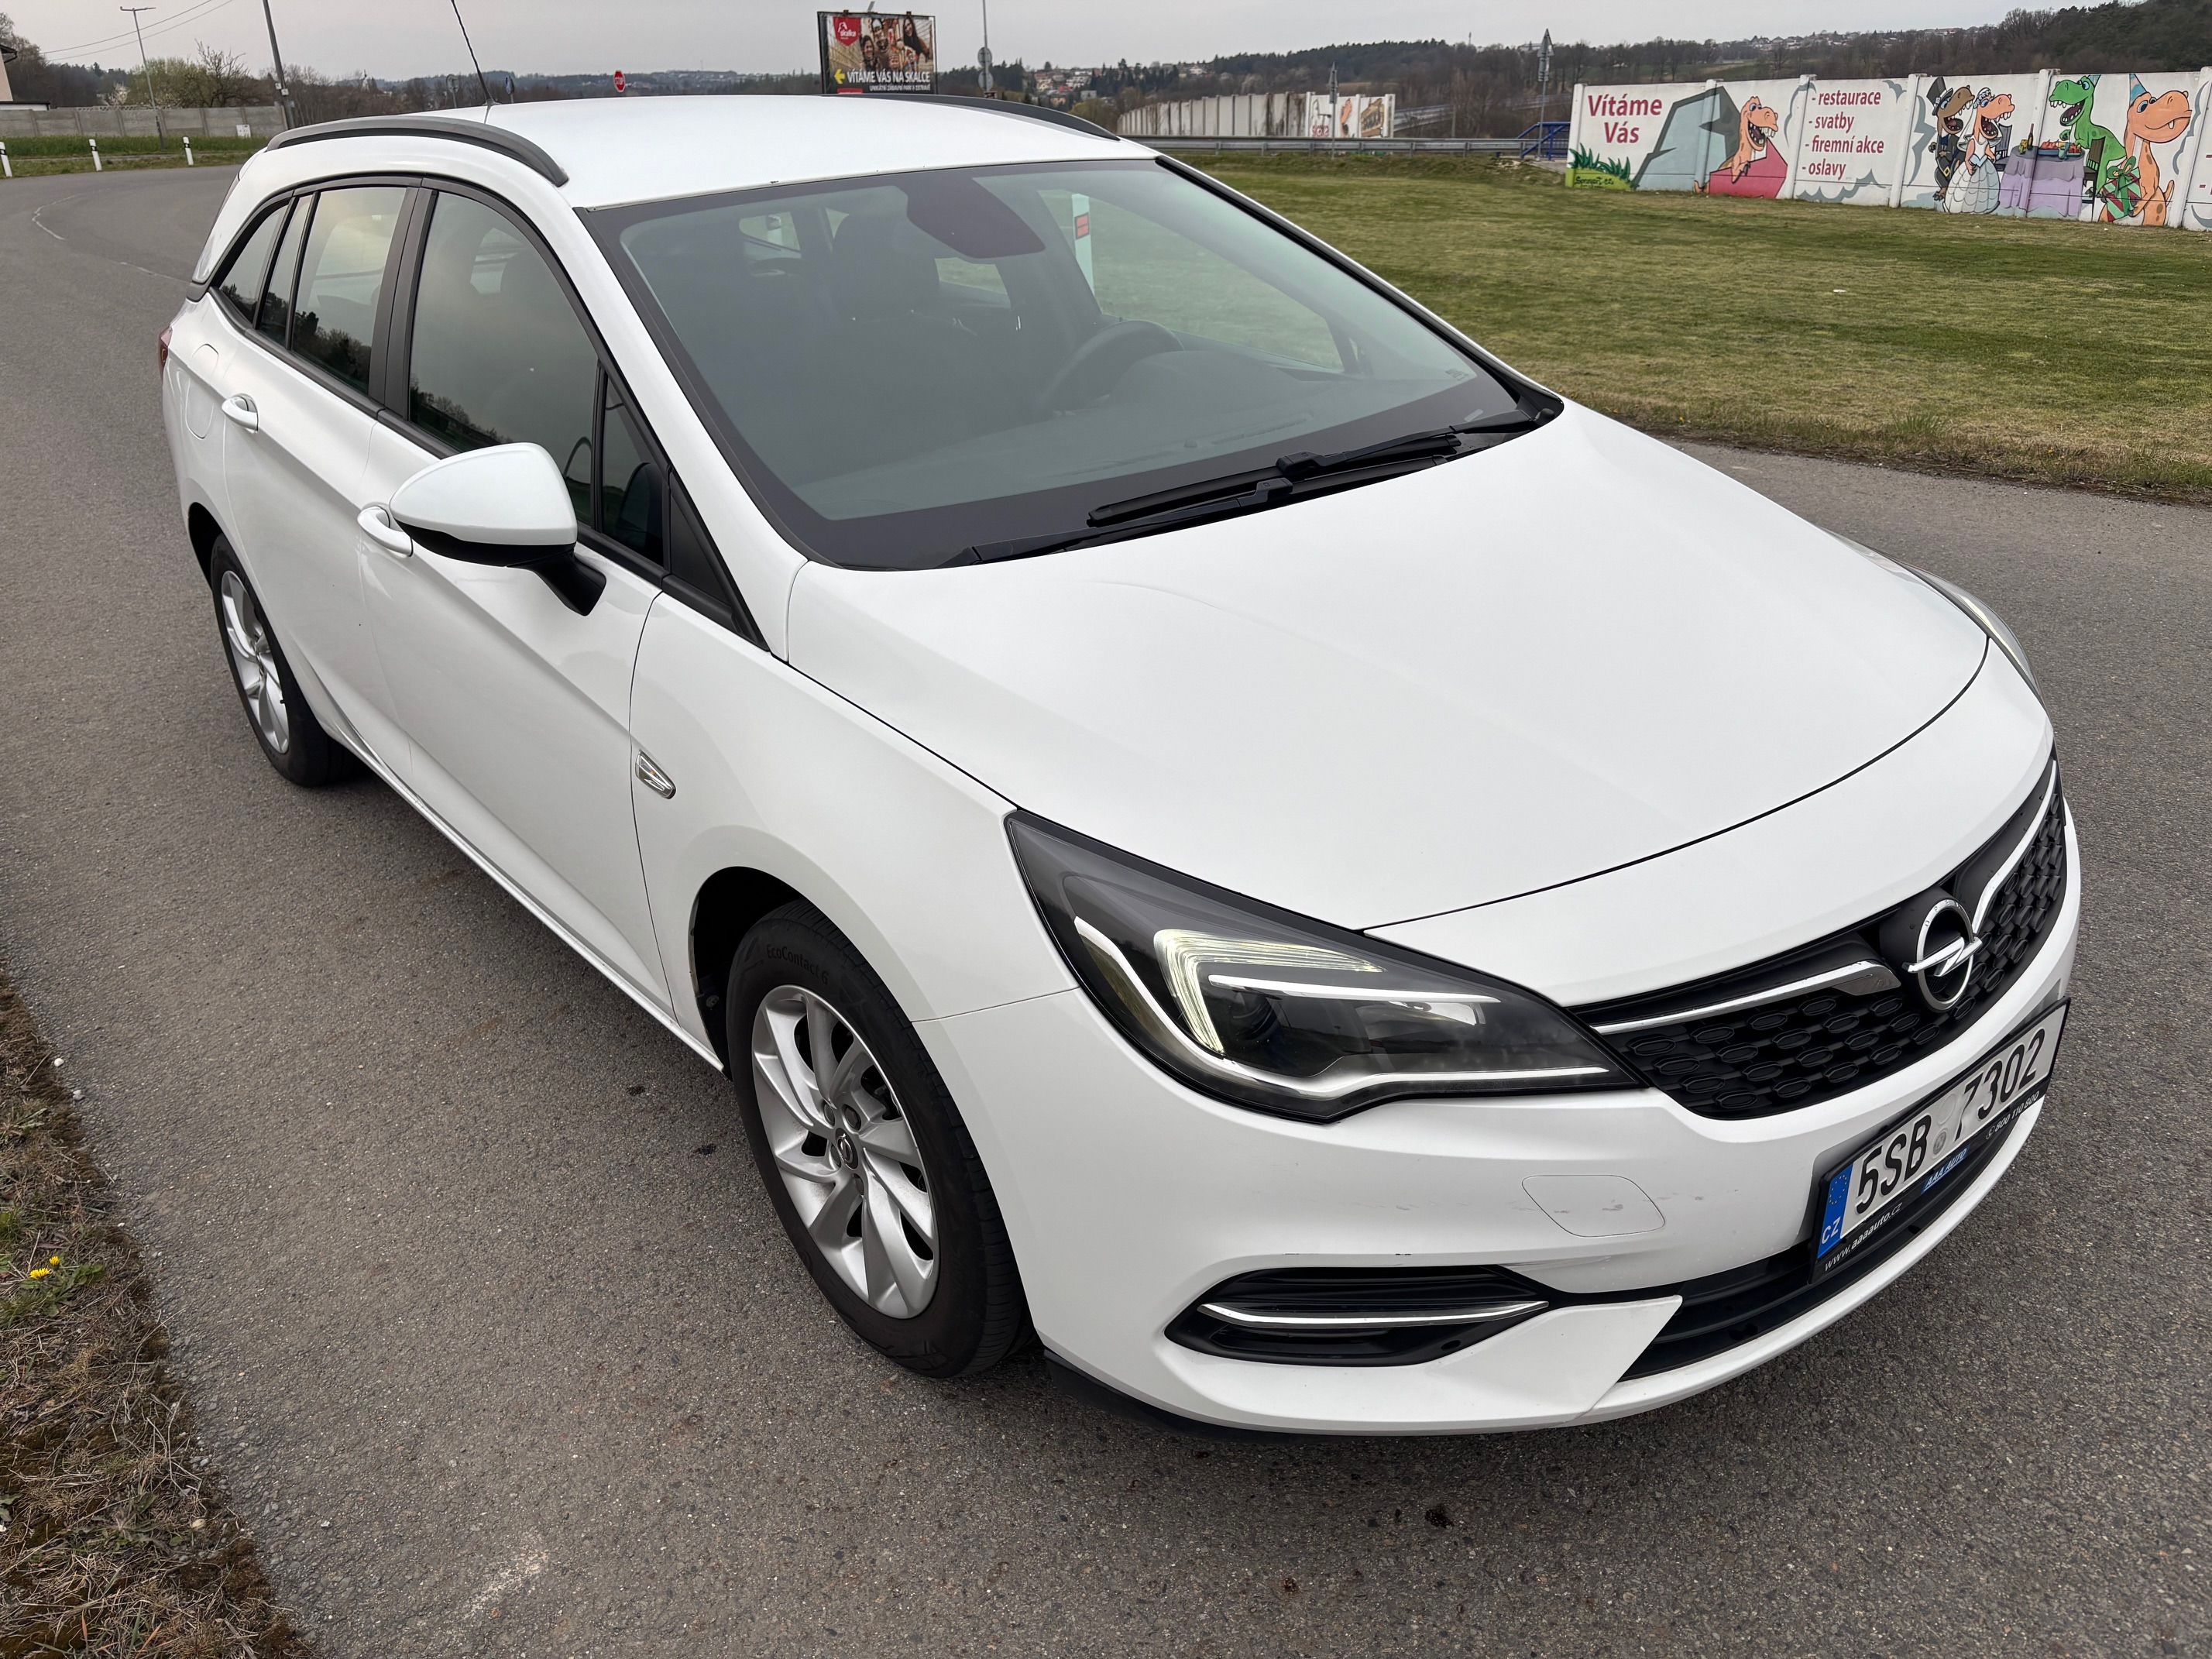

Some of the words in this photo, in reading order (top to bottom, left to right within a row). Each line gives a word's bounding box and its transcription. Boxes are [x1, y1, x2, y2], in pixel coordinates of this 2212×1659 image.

[847, 68, 876, 83] VÍTÁME
[876, 68, 891, 83] VÁS
[892, 70, 904, 83] NA
[905, 70, 930, 83] SKALCE
[1588, 93, 1662, 116] Vítáme
[1818, 89, 1881, 105] restaurace
[1604, 121, 1640, 143] Vás
[1814, 111, 1855, 134] svatby
[1812, 134, 1856, 153] firemní
[1856, 135, 1884, 154] akce
[1808, 158, 1846, 181] oslavy
[767, 944, 819, 979] EcoContact
[821, 970, 830, 985] 6
[1856, 1115, 1932, 1214] 5SB
[1955, 1028, 2045, 1142] 7302
[1994, 1114, 2011, 1132] 800
[2011, 1102, 2025, 1120] 110
[2024, 1091, 2040, 1109] 800
[1821, 1216, 1841, 1245] CZ
[1825, 1201, 1903, 1272] www.aaaauto.cz
